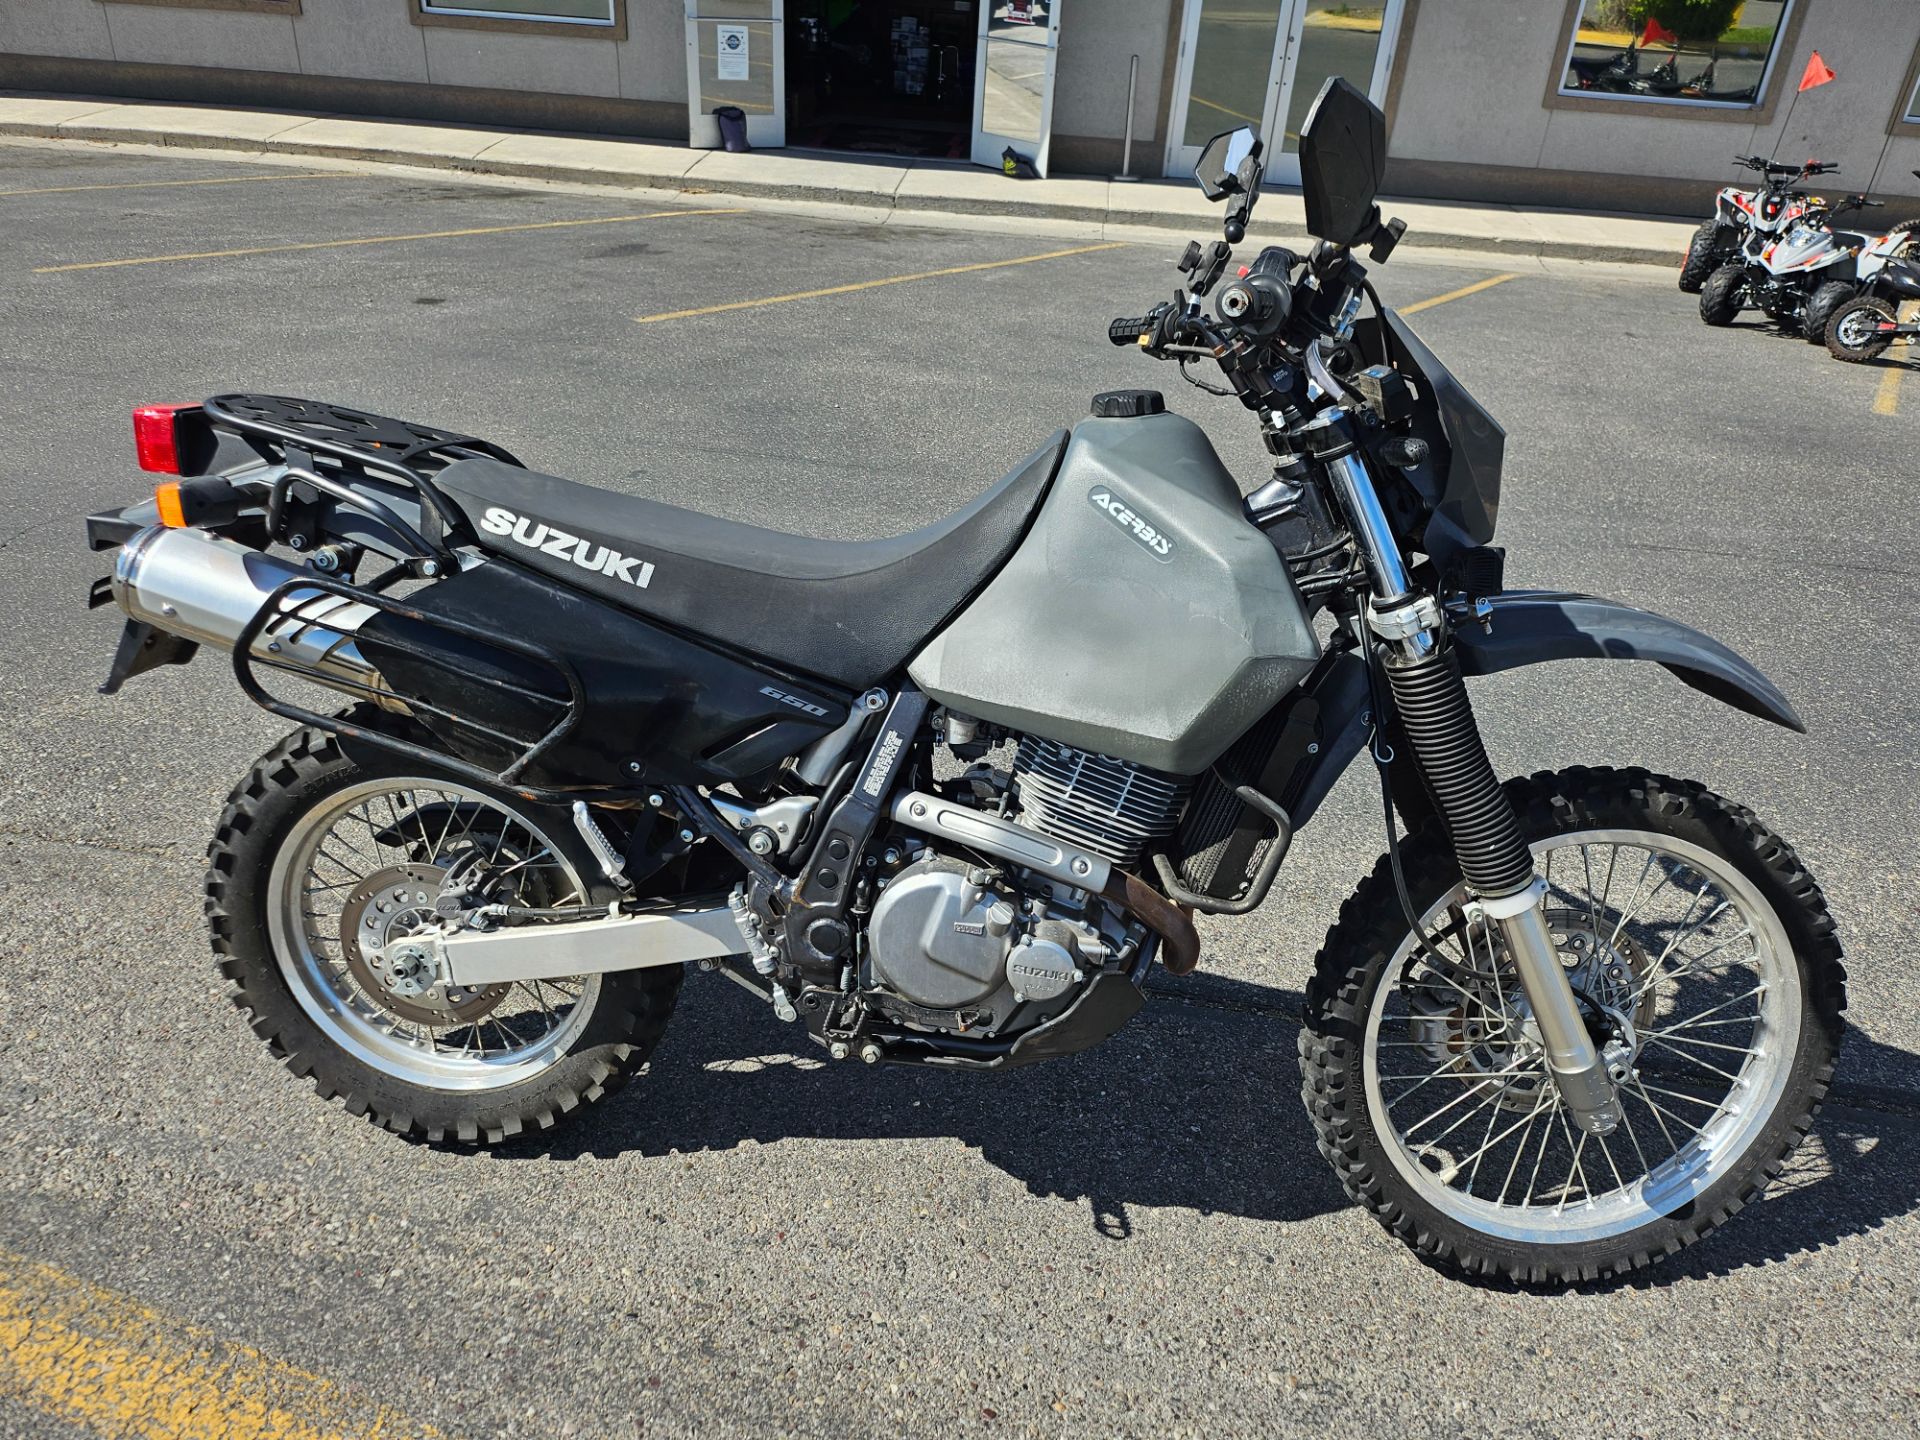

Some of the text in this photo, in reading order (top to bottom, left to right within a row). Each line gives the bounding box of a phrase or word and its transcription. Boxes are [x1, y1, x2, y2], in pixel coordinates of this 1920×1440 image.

[1091, 493, 1171, 555] ACERBIS
[480, 507, 656, 589] SUZUKI
[759, 686, 829, 717] 650
[1012, 964, 1069, 982] SUZUKI
